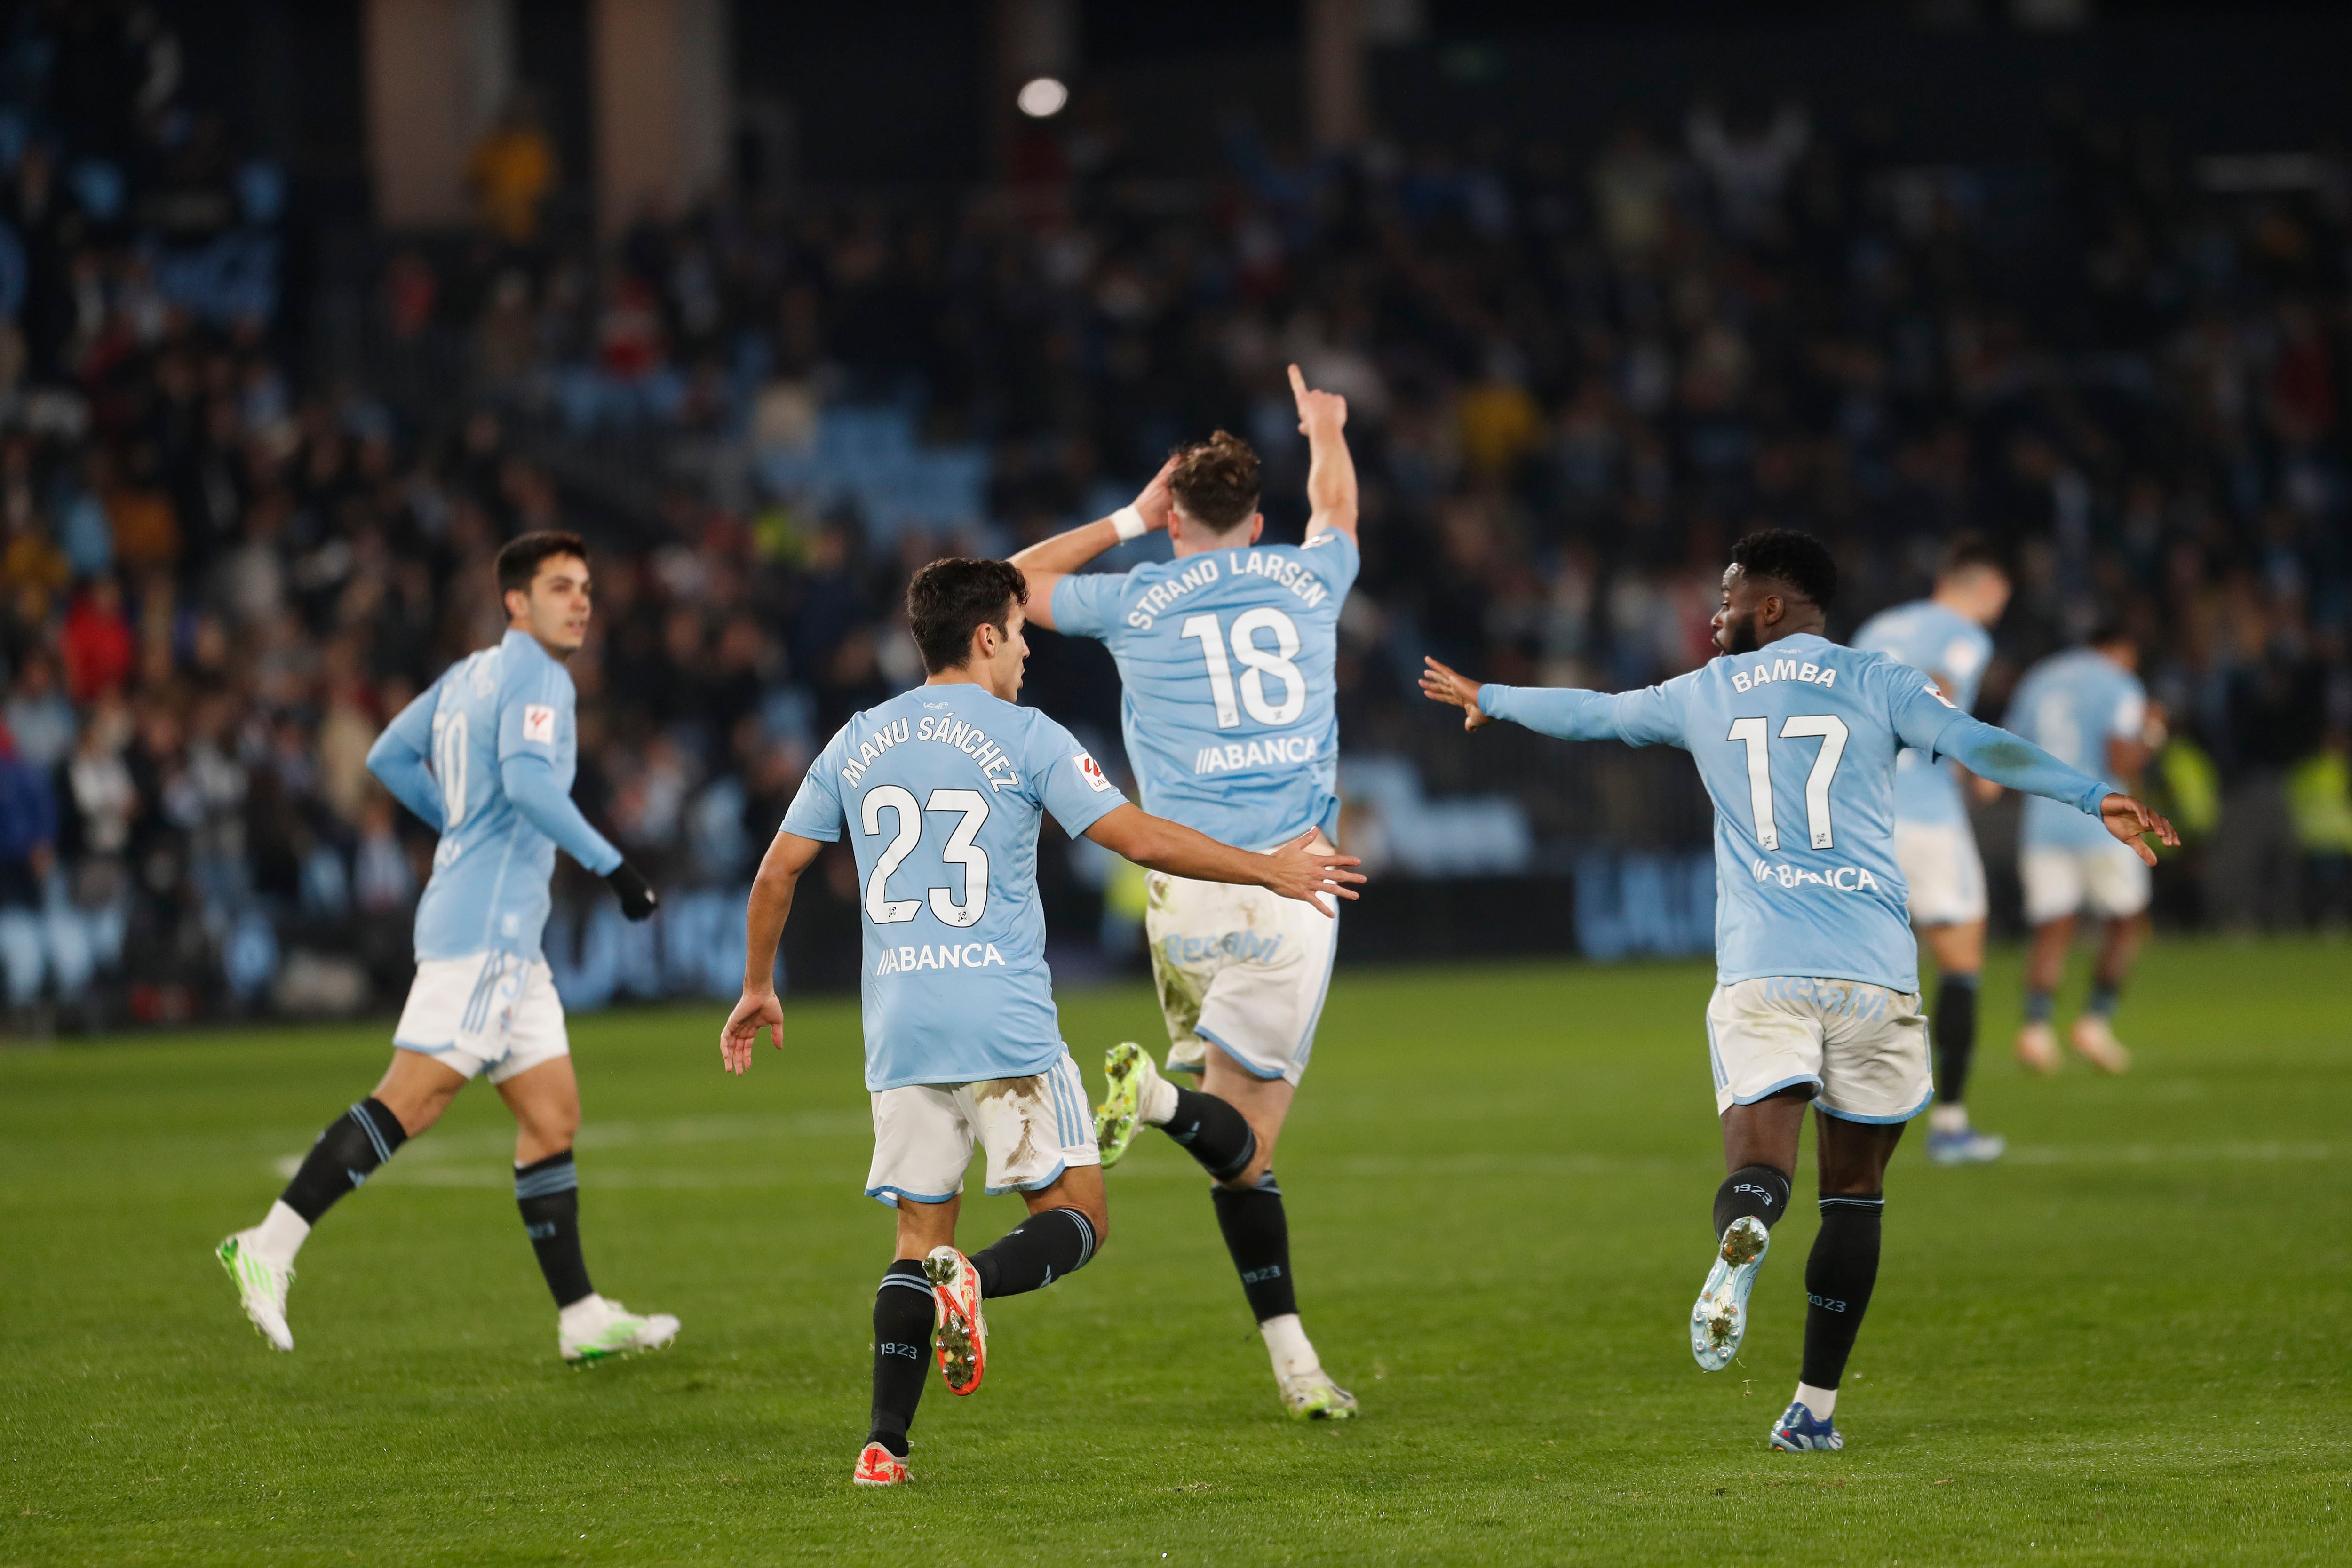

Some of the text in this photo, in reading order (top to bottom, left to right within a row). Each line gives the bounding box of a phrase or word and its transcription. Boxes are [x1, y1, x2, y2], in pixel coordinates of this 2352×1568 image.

[1128, 551, 1327, 631] STRAND LARSEN
[1181, 607, 1307, 729] 18
[1731, 659, 1837, 694] BAMBA
[841, 712, 1020, 793] MANU SÁNCHEZ
[1726, 714, 1850, 851] 17
[861, 785, 990, 928] 23
[876, 943, 1005, 976] ABANCA
[1733, 1184, 1772, 1206] 1923
[880, 1342, 918, 1360] 1923
